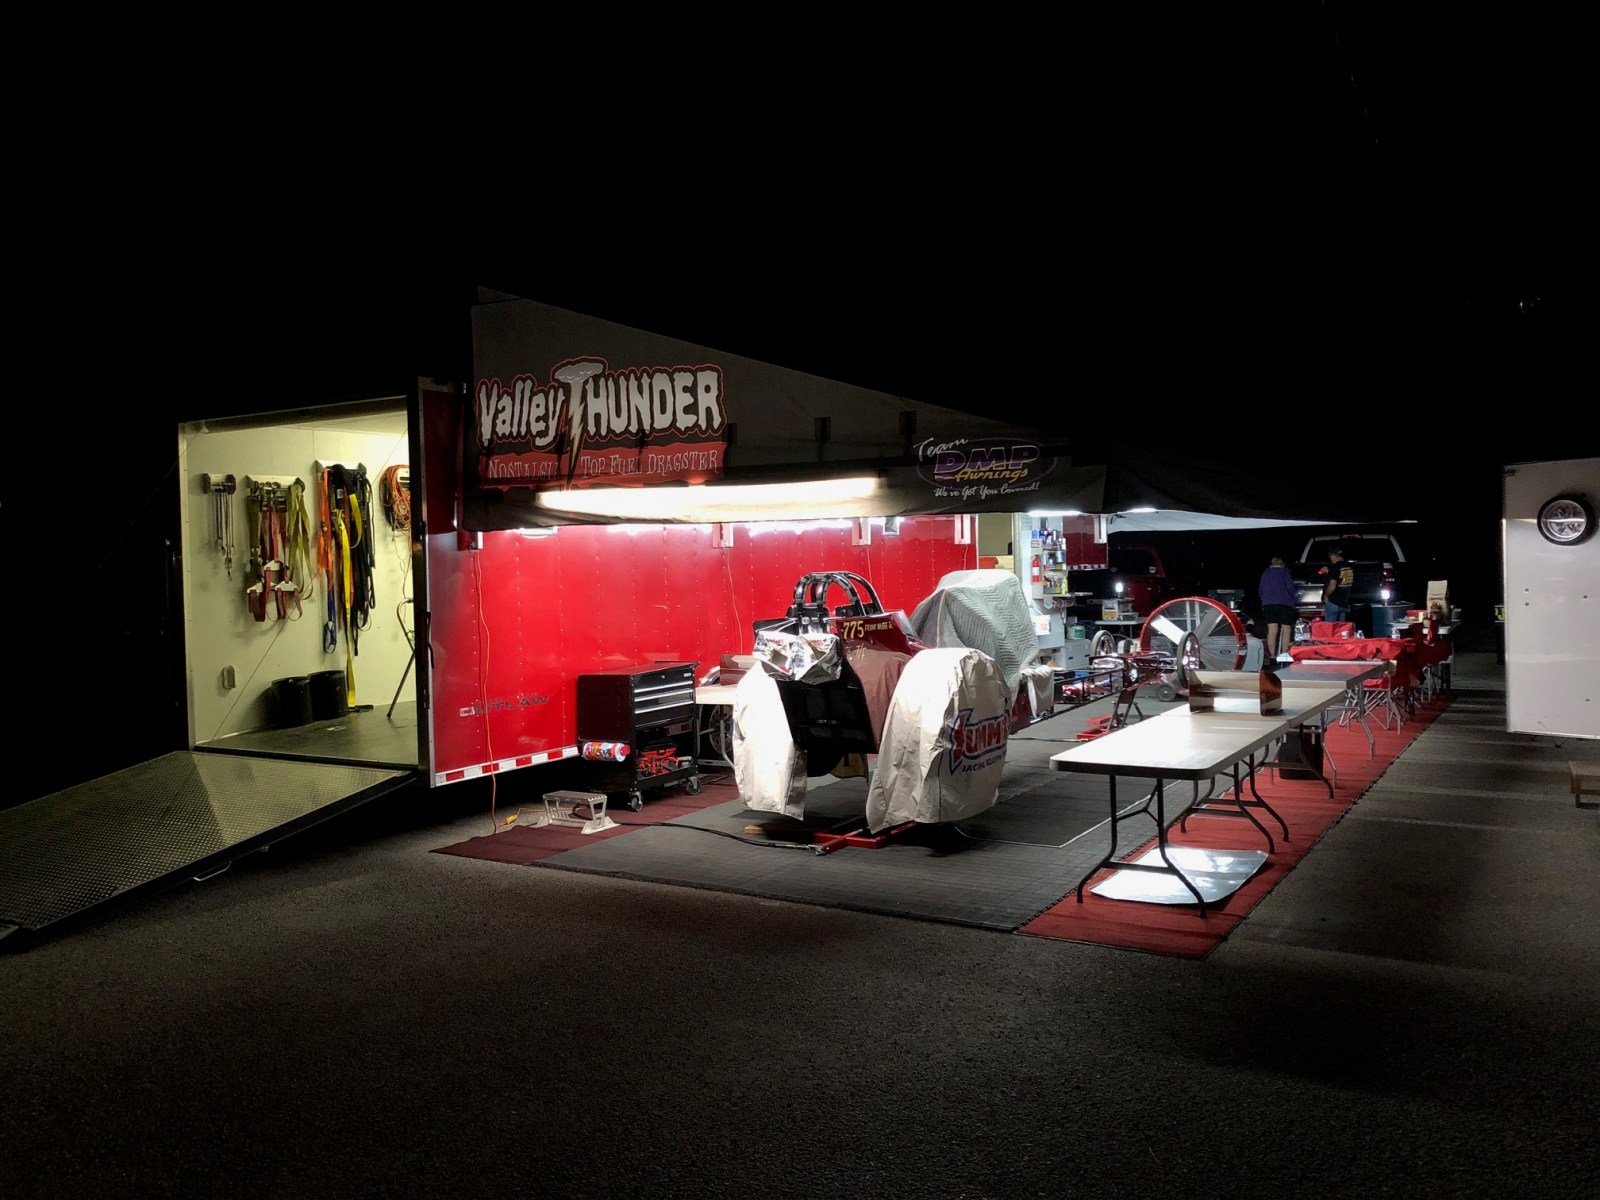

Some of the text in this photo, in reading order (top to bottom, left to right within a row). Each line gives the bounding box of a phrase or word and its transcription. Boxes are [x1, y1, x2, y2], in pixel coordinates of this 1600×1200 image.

[479, 362, 722, 462] Valley THUNDER
[913, 437, 968, 462] Team
[934, 445, 1040, 474] DMP
[580, 456, 605, 479] TOP
[646, 450, 720, 476] DRAGSTER
[945, 466, 1029, 483] Awnings
[934, 481, 1040, 500] We've Got You Covered!
[842, 620, 865, 640] 775
